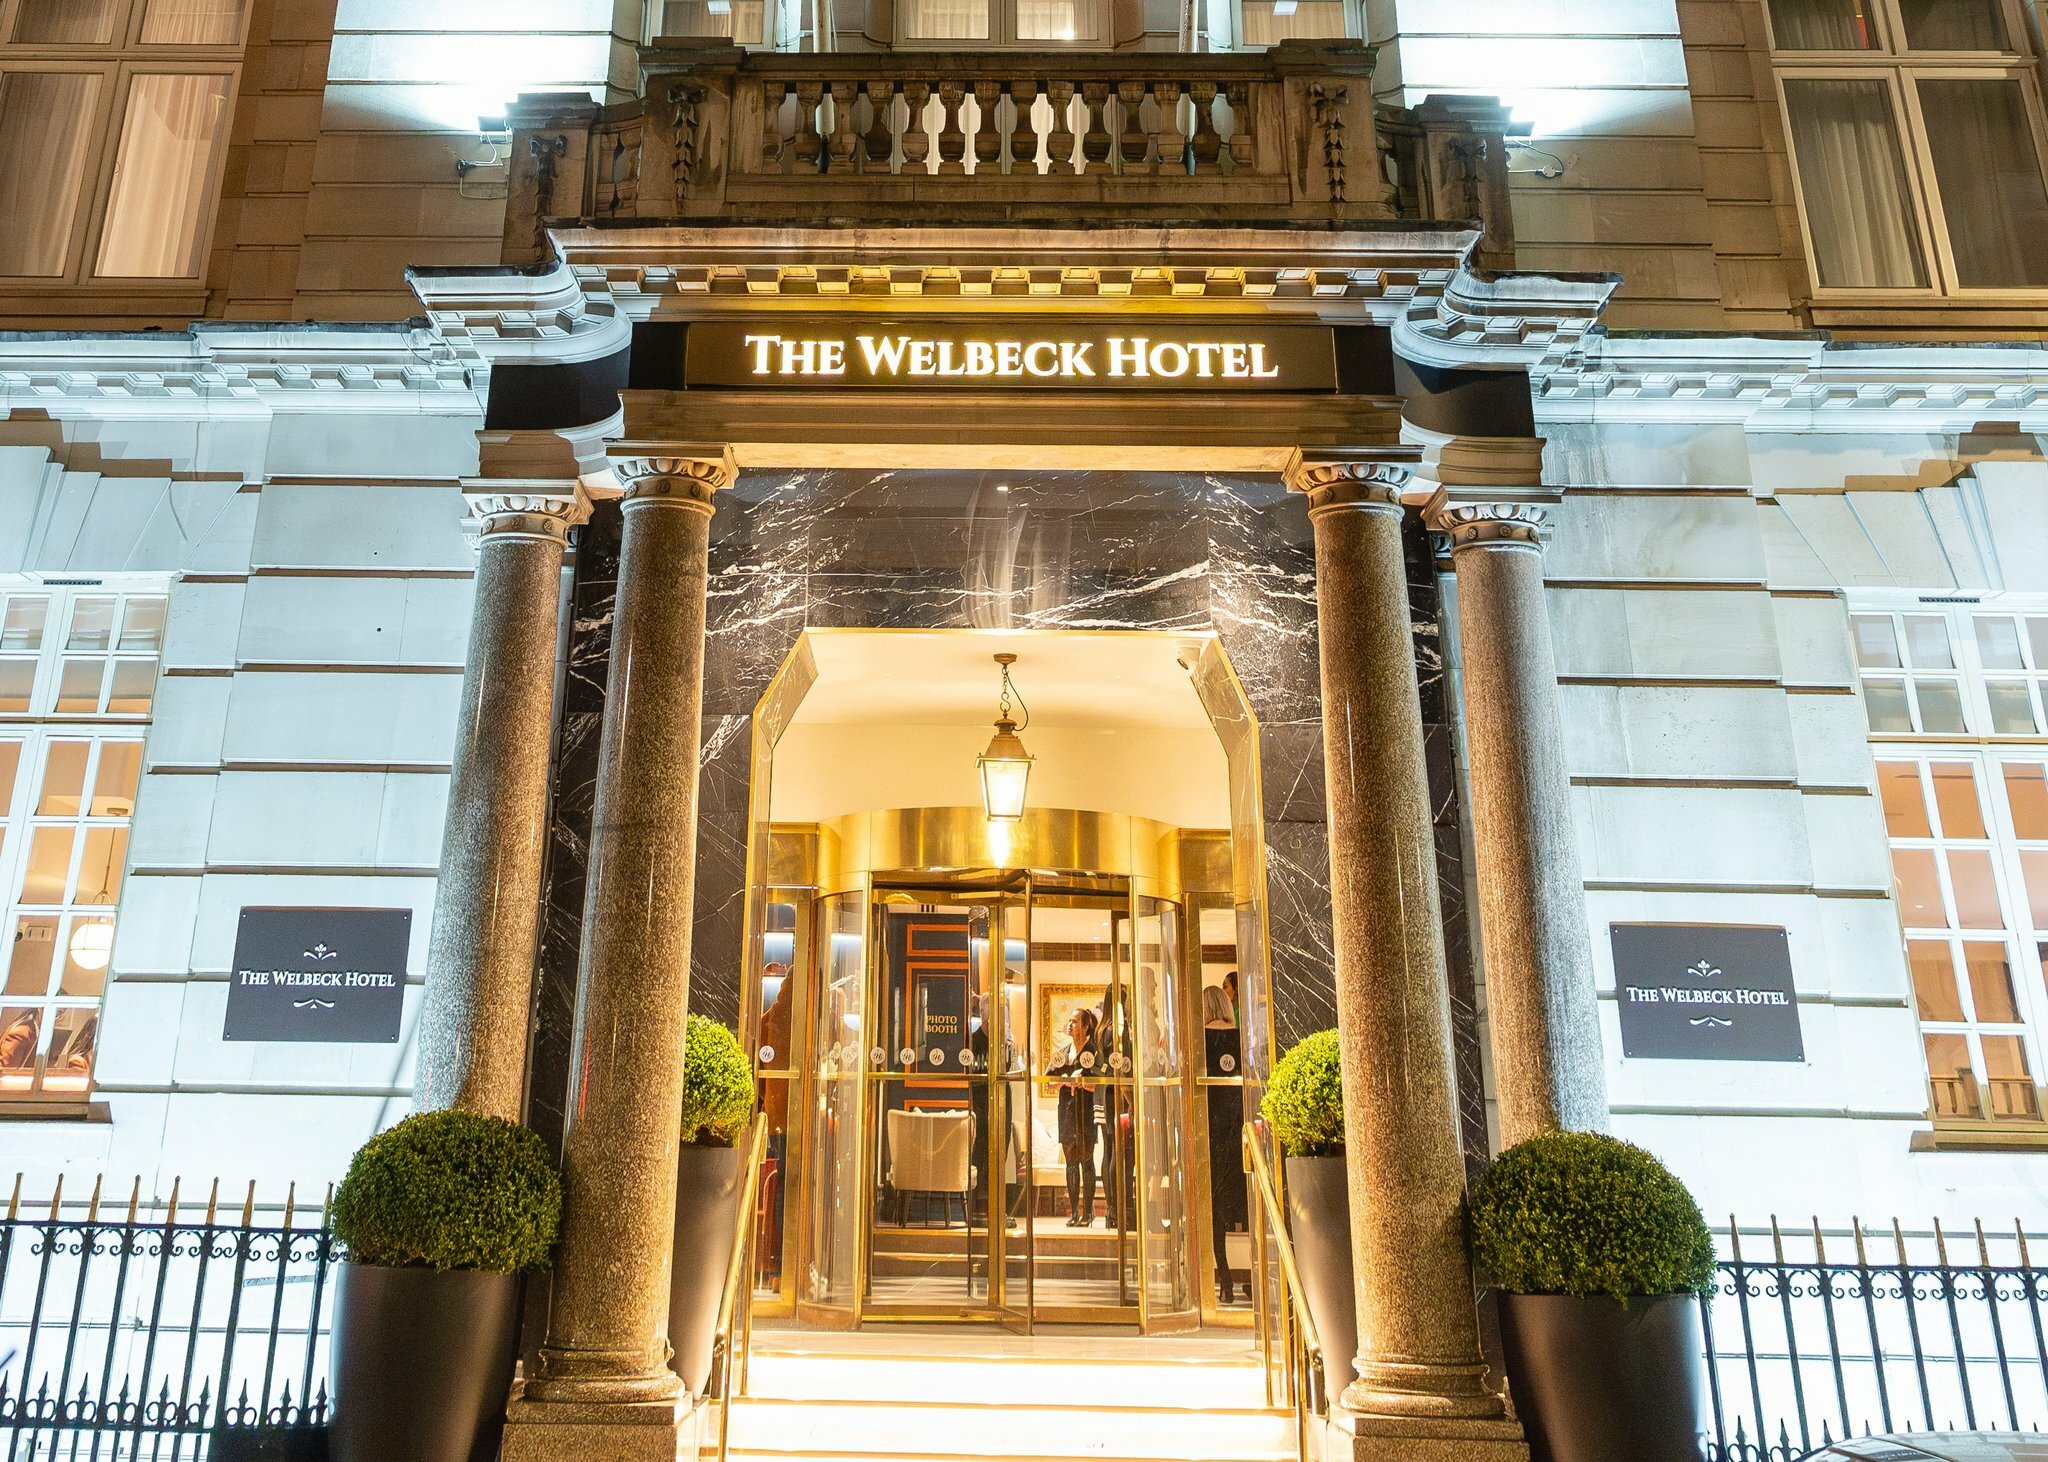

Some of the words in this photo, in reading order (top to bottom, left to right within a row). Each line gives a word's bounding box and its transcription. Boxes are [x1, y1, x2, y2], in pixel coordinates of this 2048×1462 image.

[745, 335, 846, 375] THE
[856, 336, 1097, 377] WELBECK
[1107, 338, 1280, 378] HOTEL
[239, 970, 269, 985] THE
[272, 970, 343, 986] WELBECK
[344, 971, 396, 987] HOTEL
[1626, 986, 1659, 1002] THE
[1660, 987, 1735, 1004] WELBECK
[1736, 989, 1789, 1005] HOTEL
[926, 1015, 957, 1024] PHOTO
[926, 1024, 957, 1034] BOOTH
